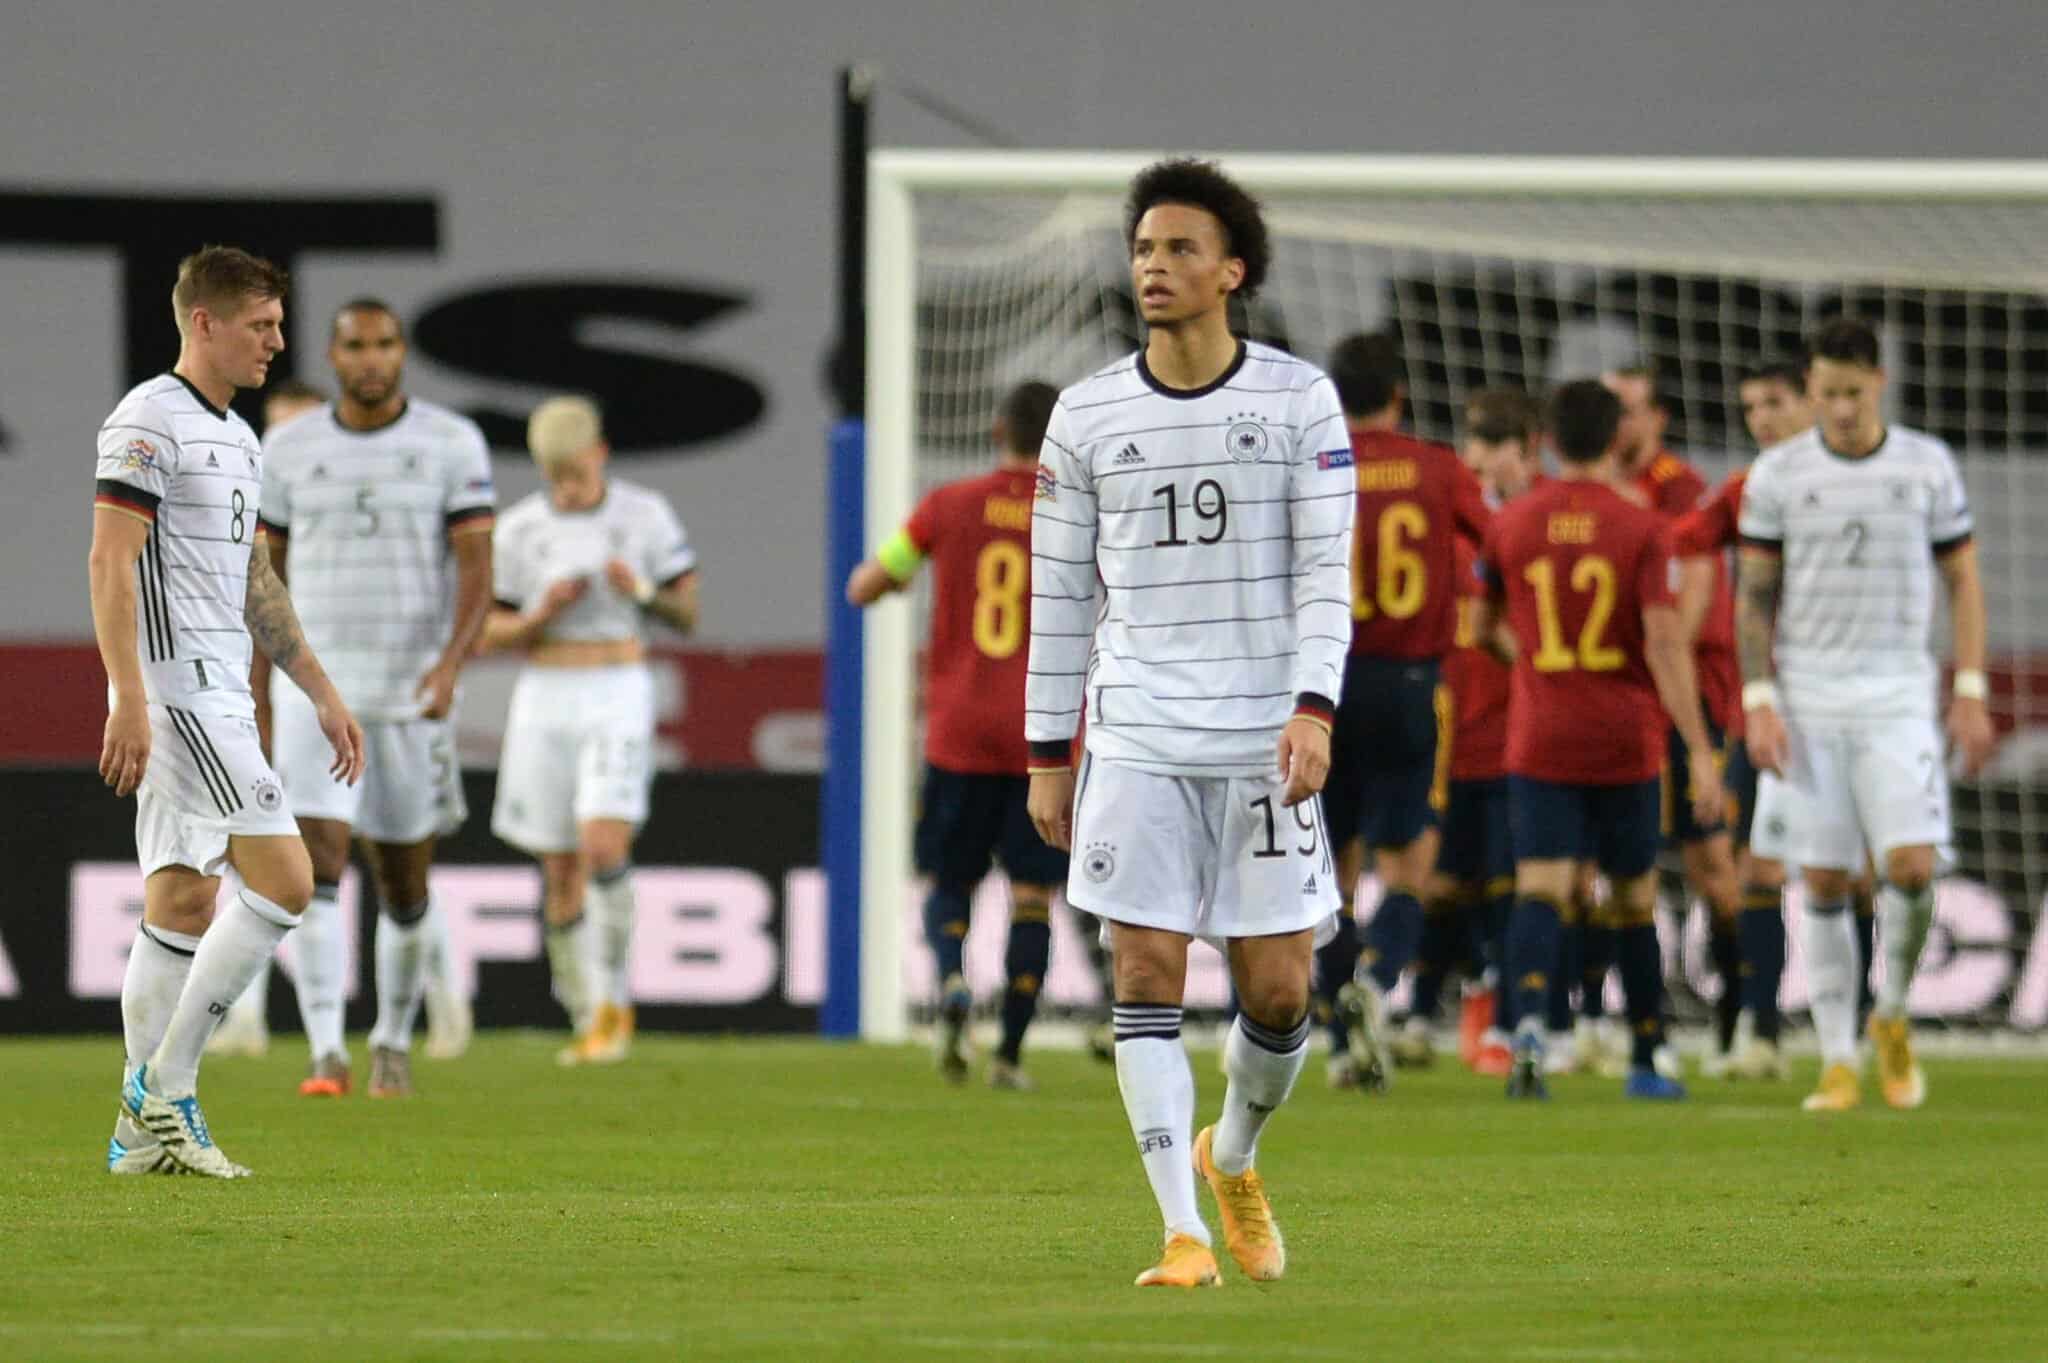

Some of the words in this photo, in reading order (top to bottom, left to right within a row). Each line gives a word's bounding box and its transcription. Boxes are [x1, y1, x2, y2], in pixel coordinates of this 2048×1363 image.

[231, 488, 246, 544] 8
[354, 481, 381, 537] 5
[1152, 479, 1227, 547] 19
[1842, 519, 1868, 567] 2
[974, 538, 1027, 660] 8
[1523, 554, 1624, 673] 12
[1249, 795, 1317, 857] 19
